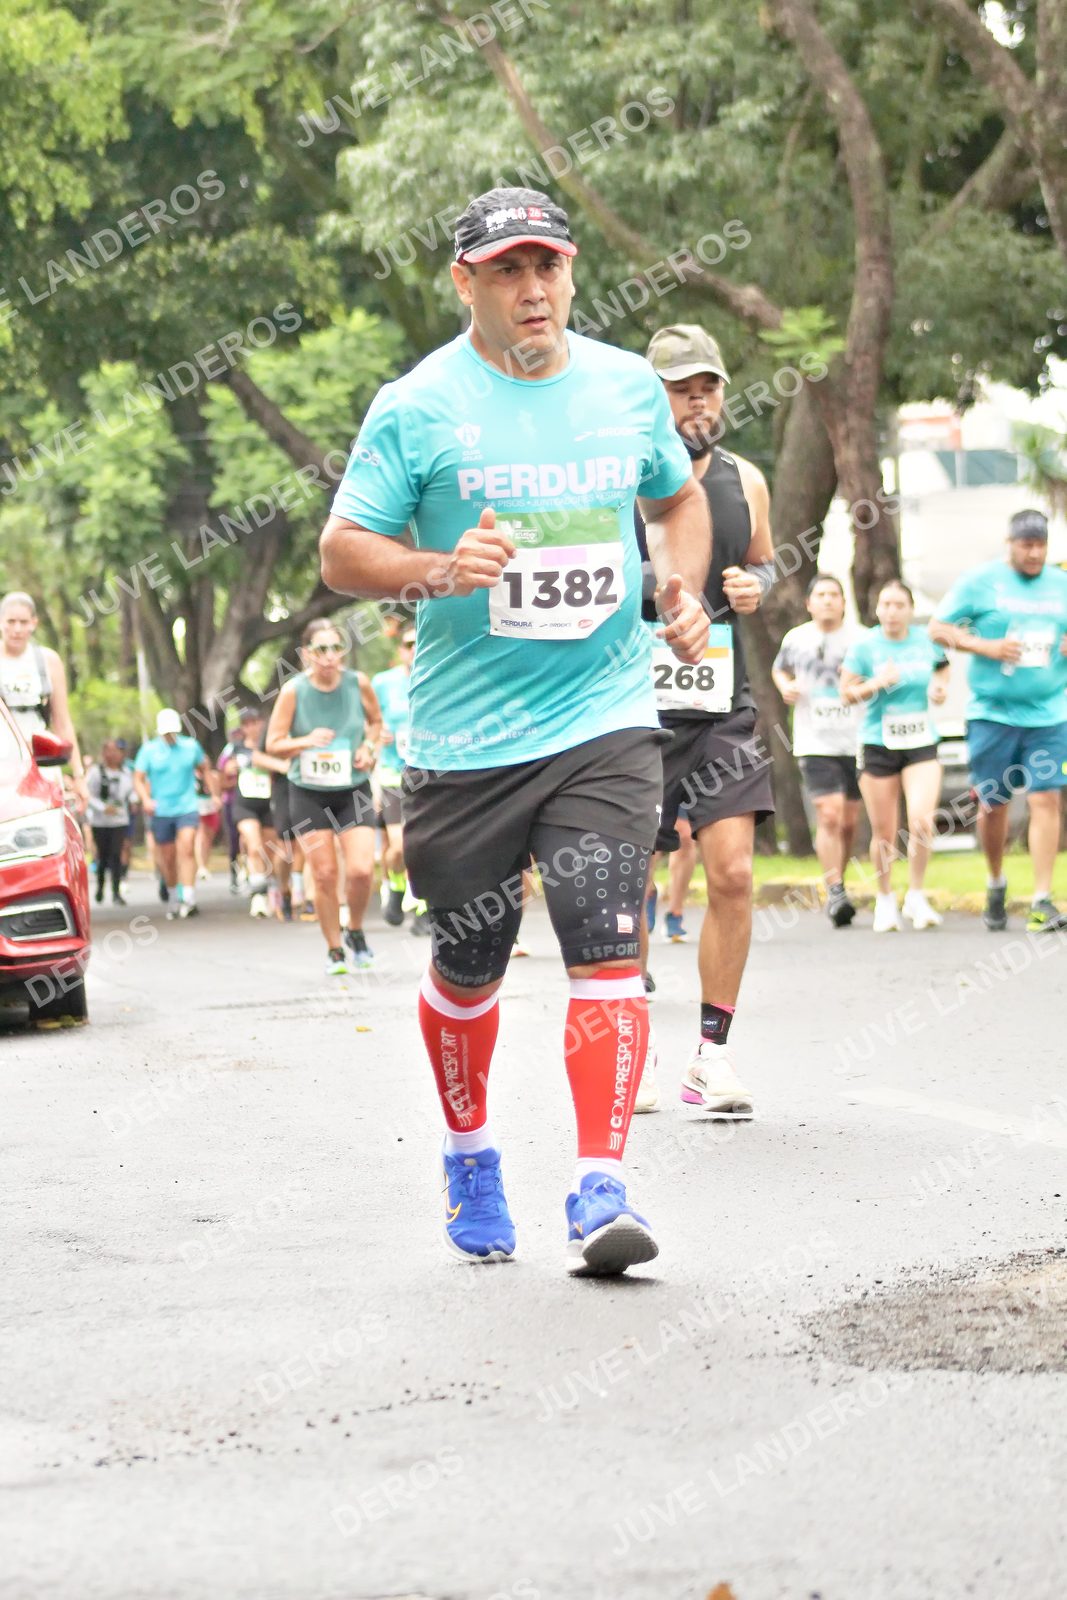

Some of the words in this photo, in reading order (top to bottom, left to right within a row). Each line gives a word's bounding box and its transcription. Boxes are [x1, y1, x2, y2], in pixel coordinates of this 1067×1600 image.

[457, 455, 636, 500] PERDURA
[502, 566, 618, 609] 1382
[501, 619, 533, 628] PERDURA
[653, 664, 715, 691] 268
[310, 760, 342, 775] 190
